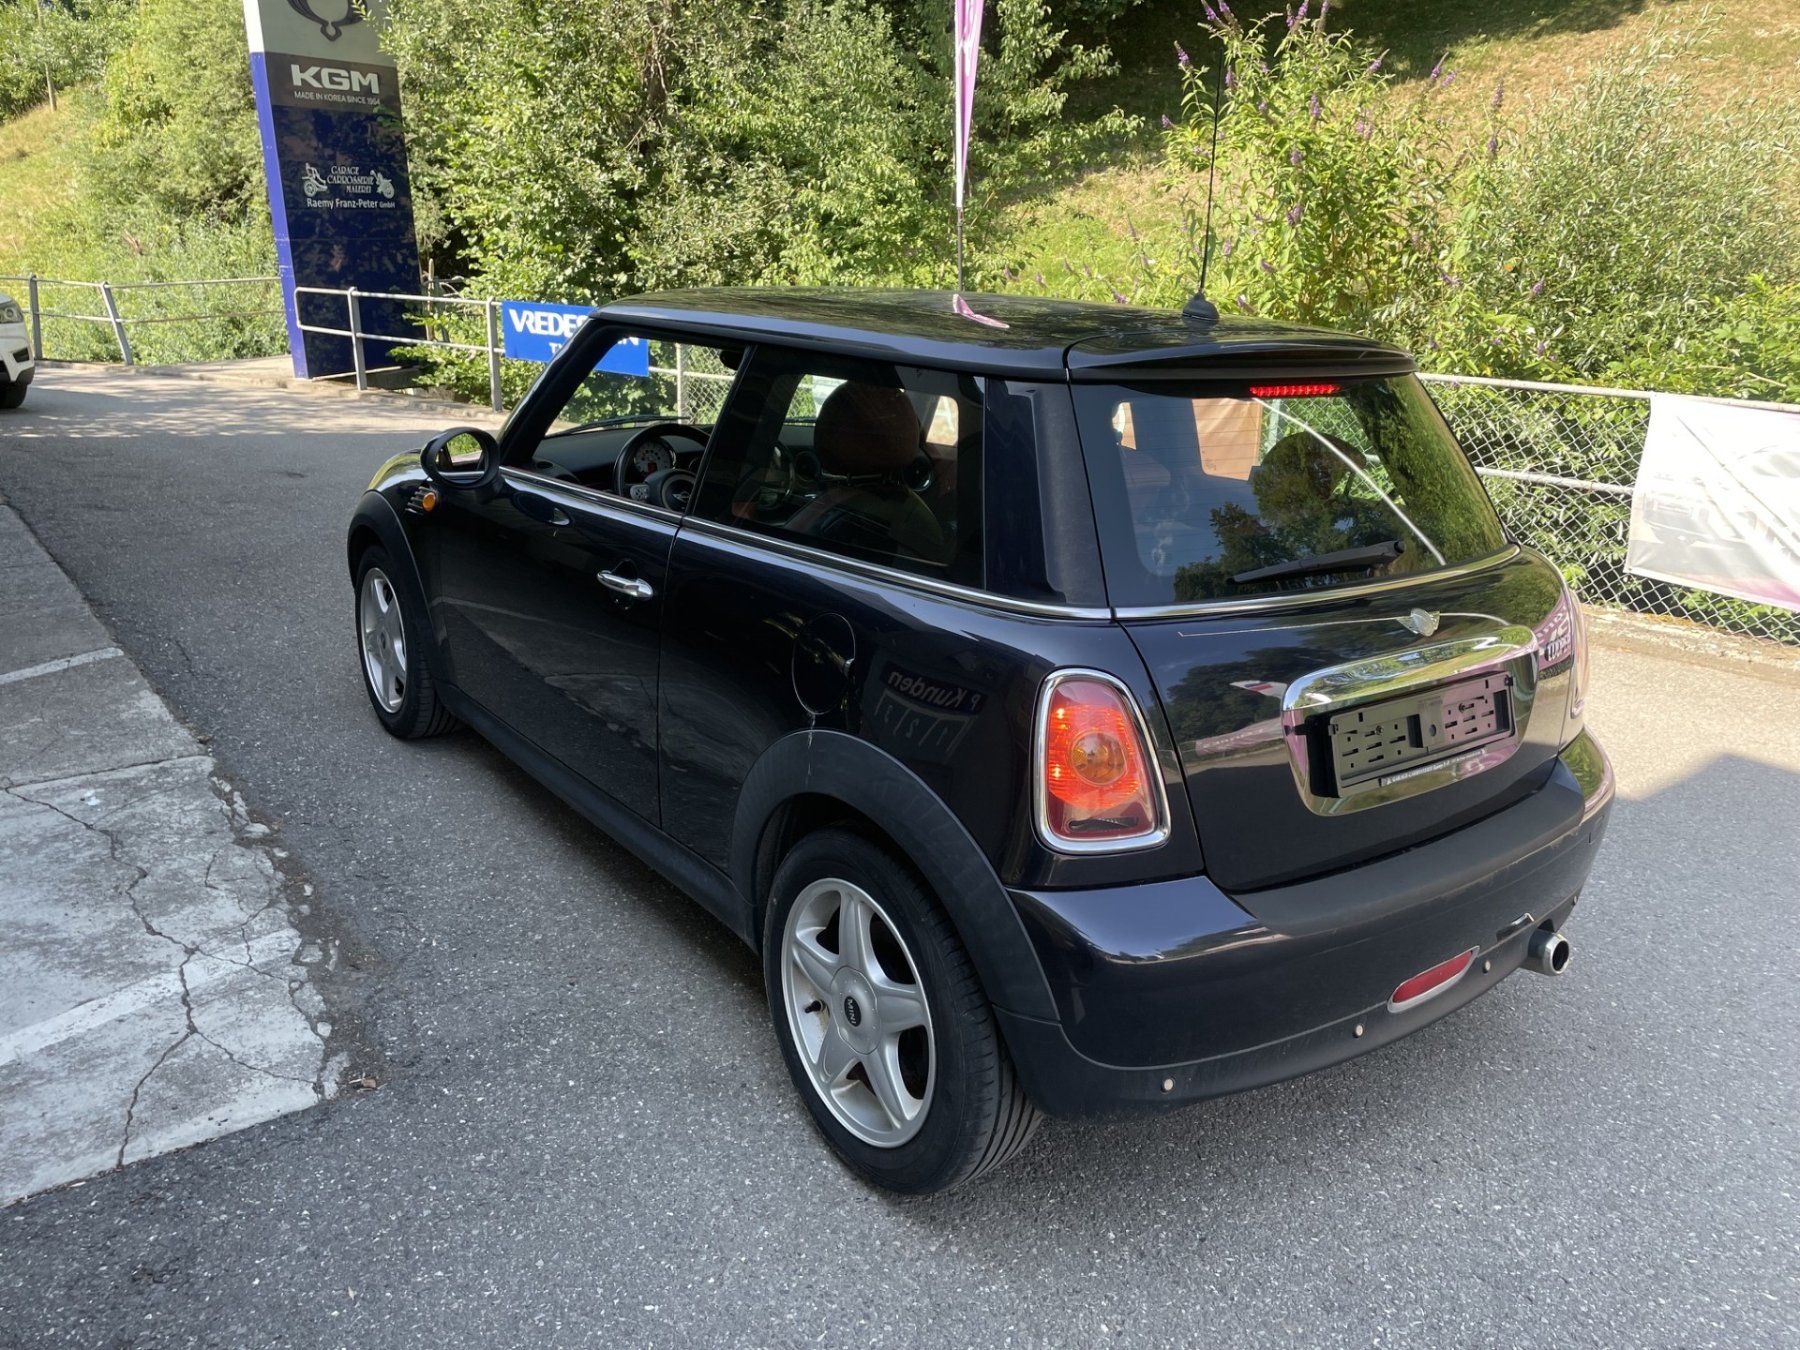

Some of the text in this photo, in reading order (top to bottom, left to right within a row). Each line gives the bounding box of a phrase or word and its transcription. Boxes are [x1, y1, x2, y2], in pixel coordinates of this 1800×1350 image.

[291, 64, 380, 94] KGM
[294, 91, 314, 100] MADE
[316, 92, 323, 100] IN
[324, 93, 346, 102] KOREA
[347, 96, 366, 105] SINCE
[331, 165, 359, 175] GARAGE
[326, 175, 374, 185] CARROSSERIE
[306, 198, 334, 210] Raemy
[335, 198, 378, 209] Franz-Peter
[847, 998, 857, 1024] MINI
